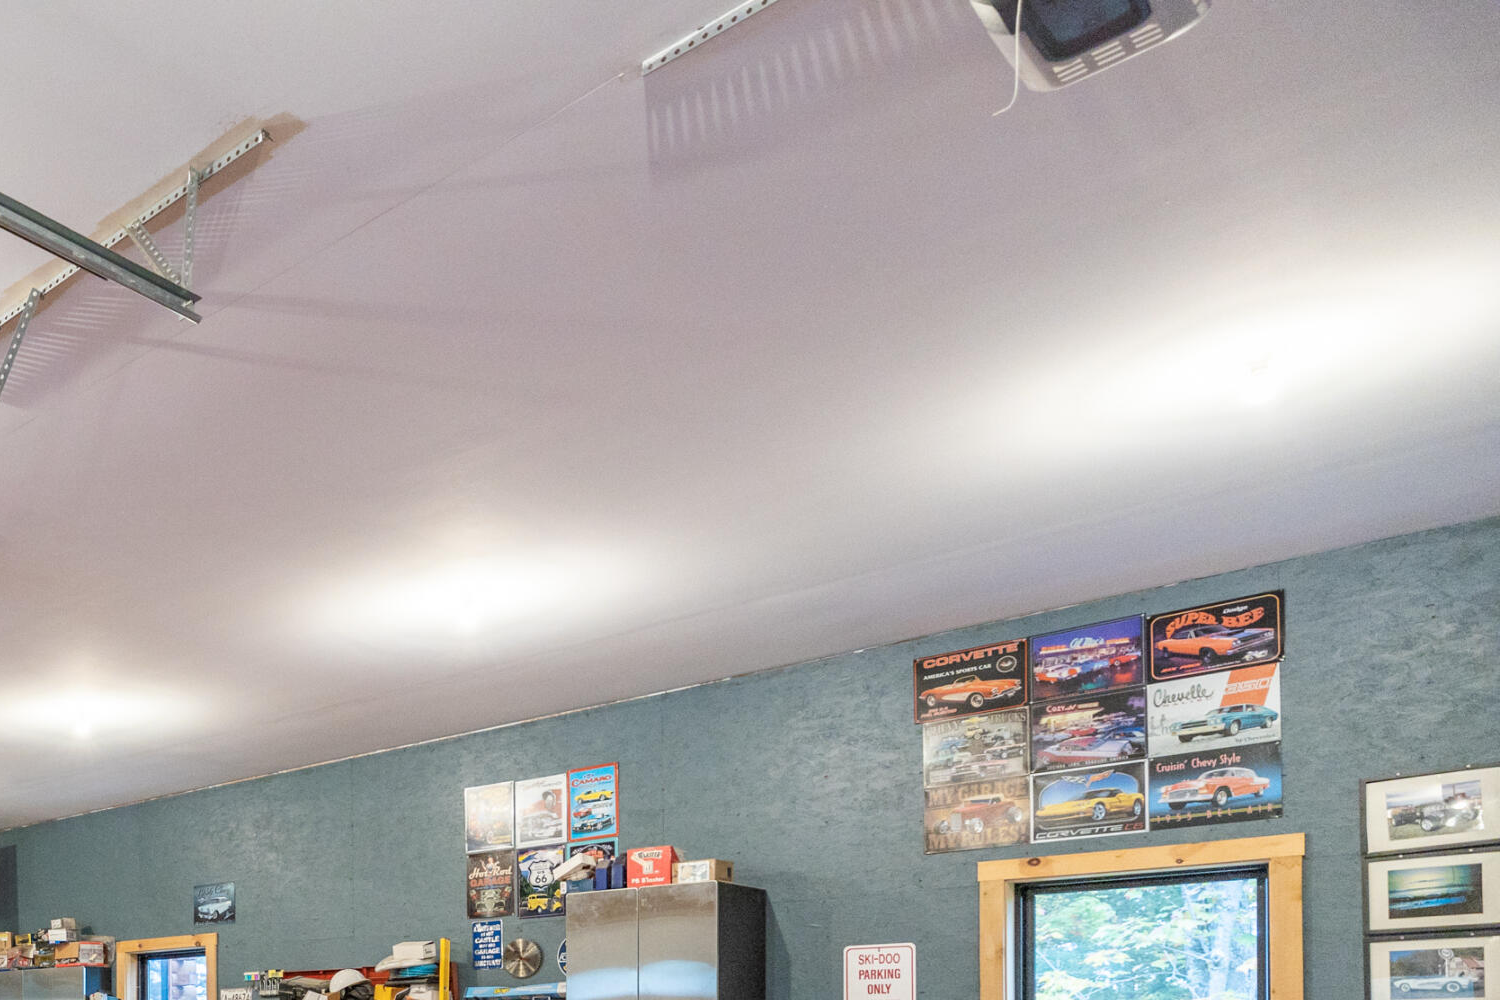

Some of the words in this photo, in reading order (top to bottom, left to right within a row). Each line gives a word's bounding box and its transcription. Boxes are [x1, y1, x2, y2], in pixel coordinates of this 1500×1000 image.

[1165, 611, 1218, 640] SUPER
[1221, 606, 1265, 628] BEE
[923, 643, 1018, 669] CORVETTE
[923, 670, 955, 681] AMERICA'S
[956, 666, 978, 675] SPORTS
[978, 663, 992, 671] CAR
[1224, 678, 1272, 694] 350
[1153, 683, 1214, 707] Chevelle
[988, 710, 1026, 723] TRUCKS
[1156, 759, 1188, 772] Cruisin'
[1191, 756, 1217, 769] Chevy
[1219, 752, 1242, 766] Style
[571, 774, 612, 788] CAMARO
[930, 786, 957, 807] MY
[959, 777, 1028, 802] GARAGE
[1156, 812, 1192, 823] 1955
[1205, 807, 1232, 819] BEL
[1247, 802, 1272, 815] AIR
[1036, 824, 1124, 839] CORVETTE
[1124, 822, 1144, 831] C6
[927, 832, 959, 850] MY
[470, 875, 511, 887] GARAGE
[534, 873, 548, 883] 66
[858, 953, 901, 965] SKI-DOO
[858, 968, 901, 980] PARKING
[867, 984, 891, 994] ONLY
